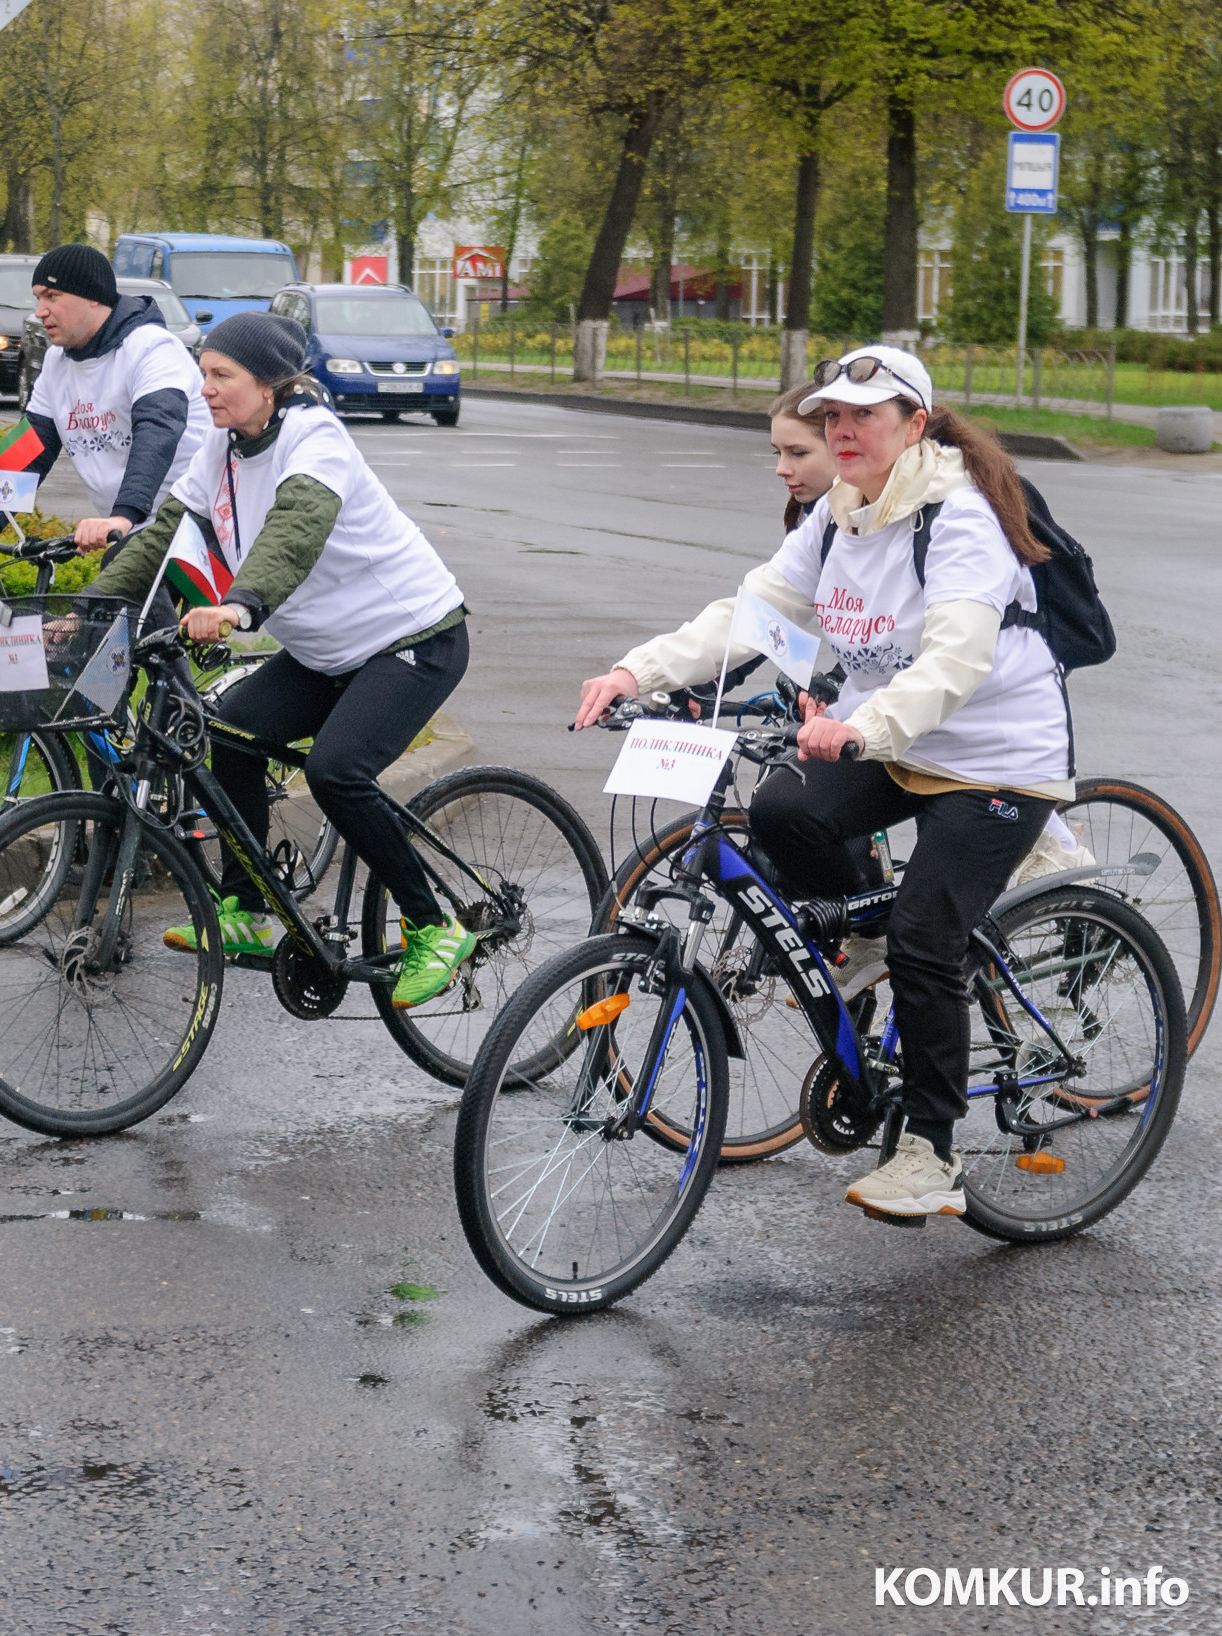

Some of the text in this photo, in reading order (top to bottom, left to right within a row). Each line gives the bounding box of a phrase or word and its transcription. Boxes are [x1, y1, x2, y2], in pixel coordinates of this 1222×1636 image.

[1016, 87, 1054, 112] 40
[456, 260, 501, 278] AMI
[827, 587, 865, 612] Моя
[814, 603, 895, 645] Беларусь
[629, 737, 723, 761] ПОЛИКЛИНИКА
[656, 758, 676, 770] №3
[988, 798, 1019, 821] FILA
[737, 885, 831, 998] STELS
[180, 981, 209, 1058] STAGE
[1023, 1211, 1084, 1232] STELS
[544, 1282, 603, 1303] STELS
